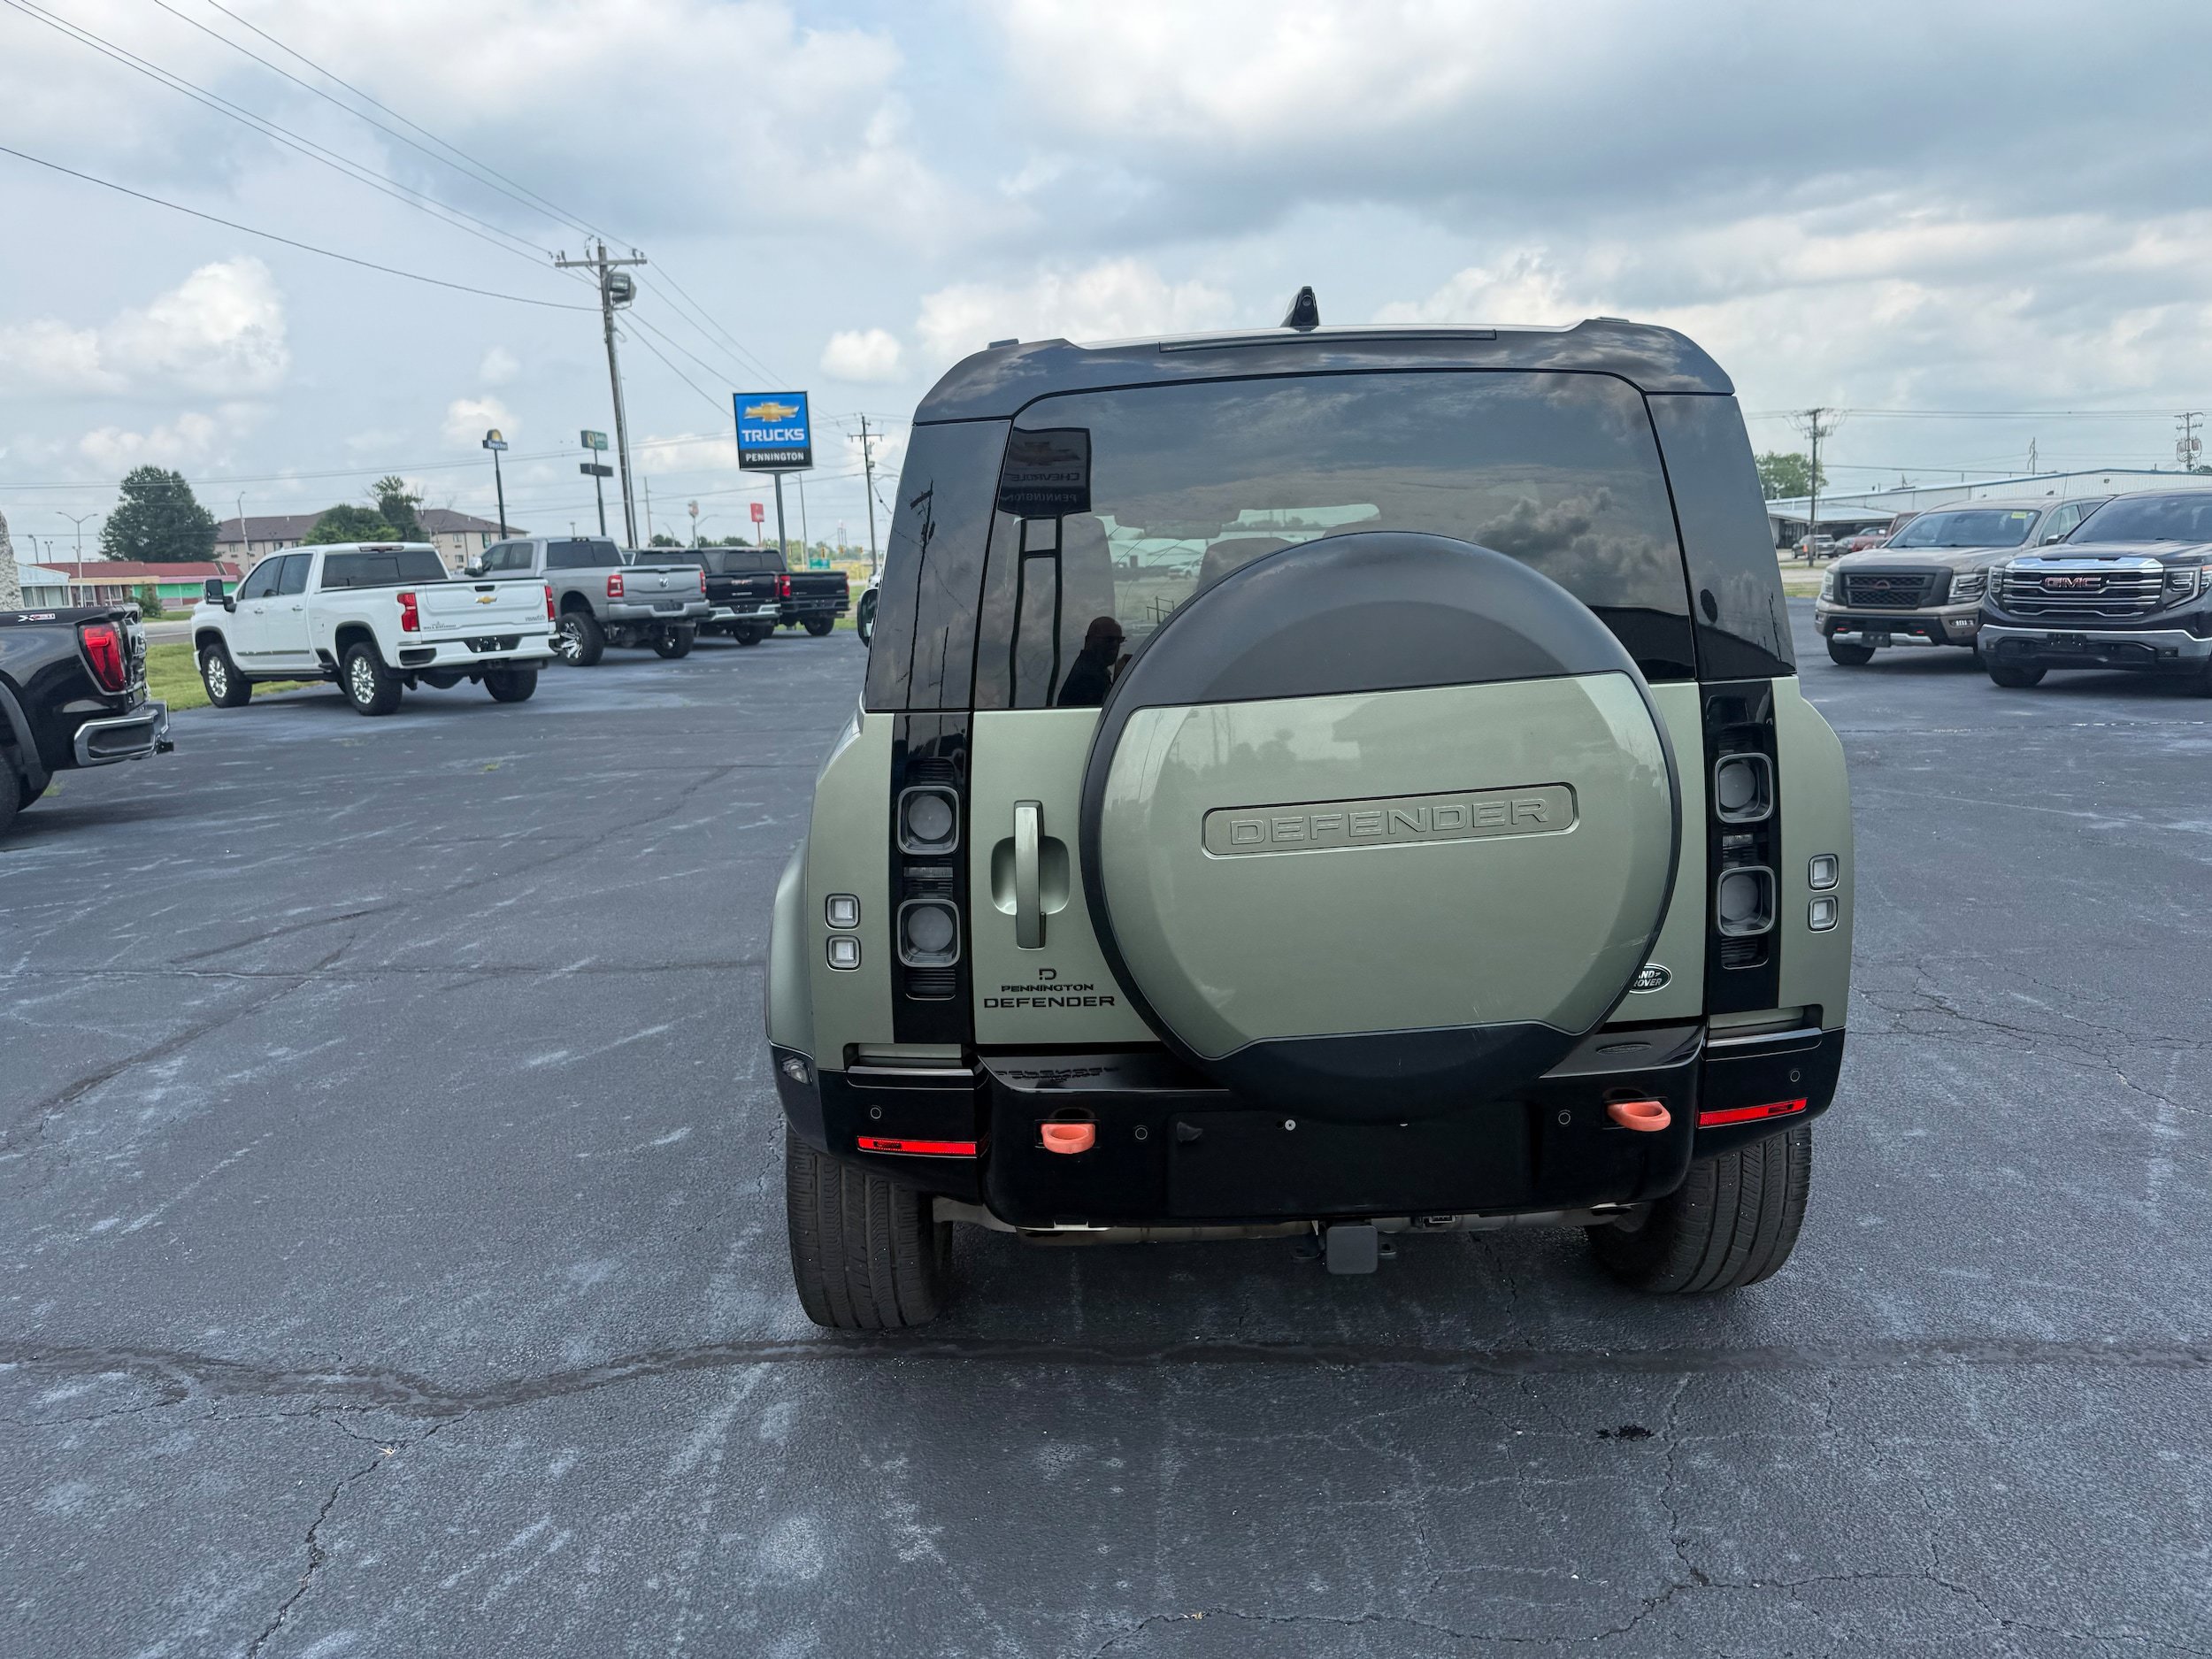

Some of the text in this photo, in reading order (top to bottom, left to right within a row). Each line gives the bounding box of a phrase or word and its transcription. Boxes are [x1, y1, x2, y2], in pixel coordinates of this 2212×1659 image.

[741, 428, 805, 442] TRUCKS
[745, 452, 804, 462] PENNINGTON
[2044, 577, 2102, 588] GMC
[1230, 798, 1549, 846] DEFENDER
[1001, 983, 1094, 993] PENNINGTON
[984, 995, 1115, 1009] DEFENDER
